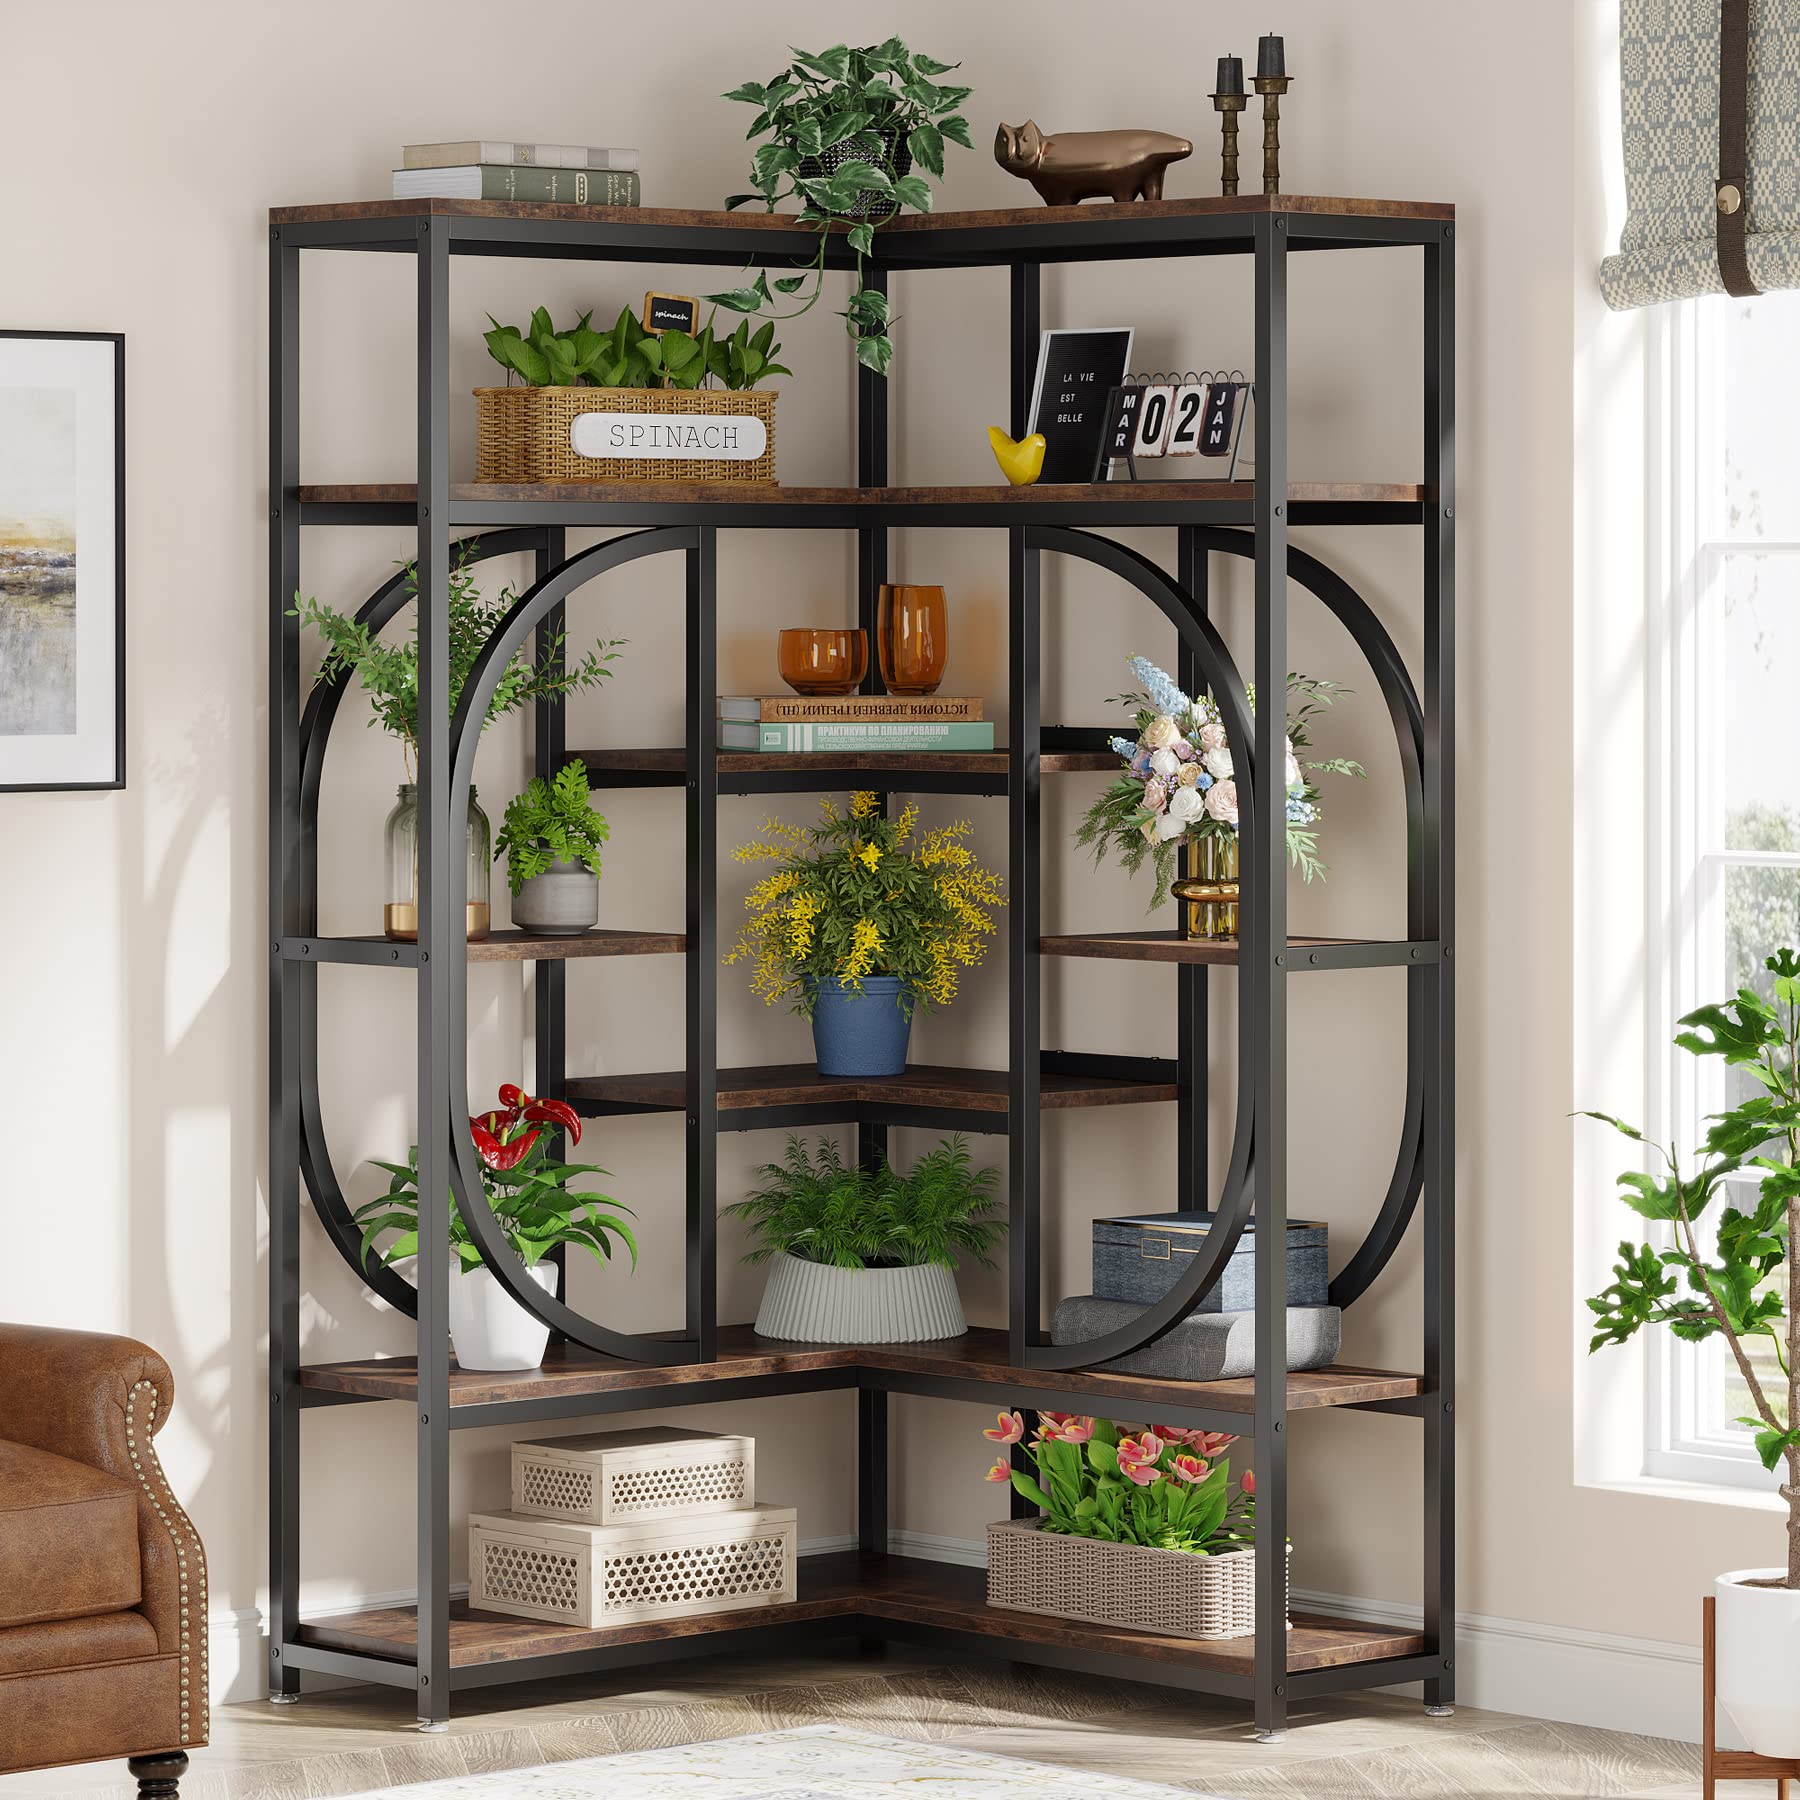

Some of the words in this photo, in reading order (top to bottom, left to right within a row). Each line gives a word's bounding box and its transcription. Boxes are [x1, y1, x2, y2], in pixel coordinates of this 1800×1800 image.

[654, 310, 689, 321] spinach
[1063, 373, 1073, 383] LA
[1080, 372, 1095, 382] VIE
[1060, 393, 1076, 403] EST
[1057, 413, 1083, 423] BELLE
[609, 424, 739, 449] SPINACH
[802, 703, 850, 716] ГРЕЦИИ
[852, 703, 908, 717] ДРЕВНЕЙ
[910, 704, 969, 716] ИСТОРИЯ
[817, 725, 867, 737] ПРАКТИКУМ
[867, 725, 880, 736] ПО
[881, 725, 949, 736] ПЛАНИРОВАНИЮ
